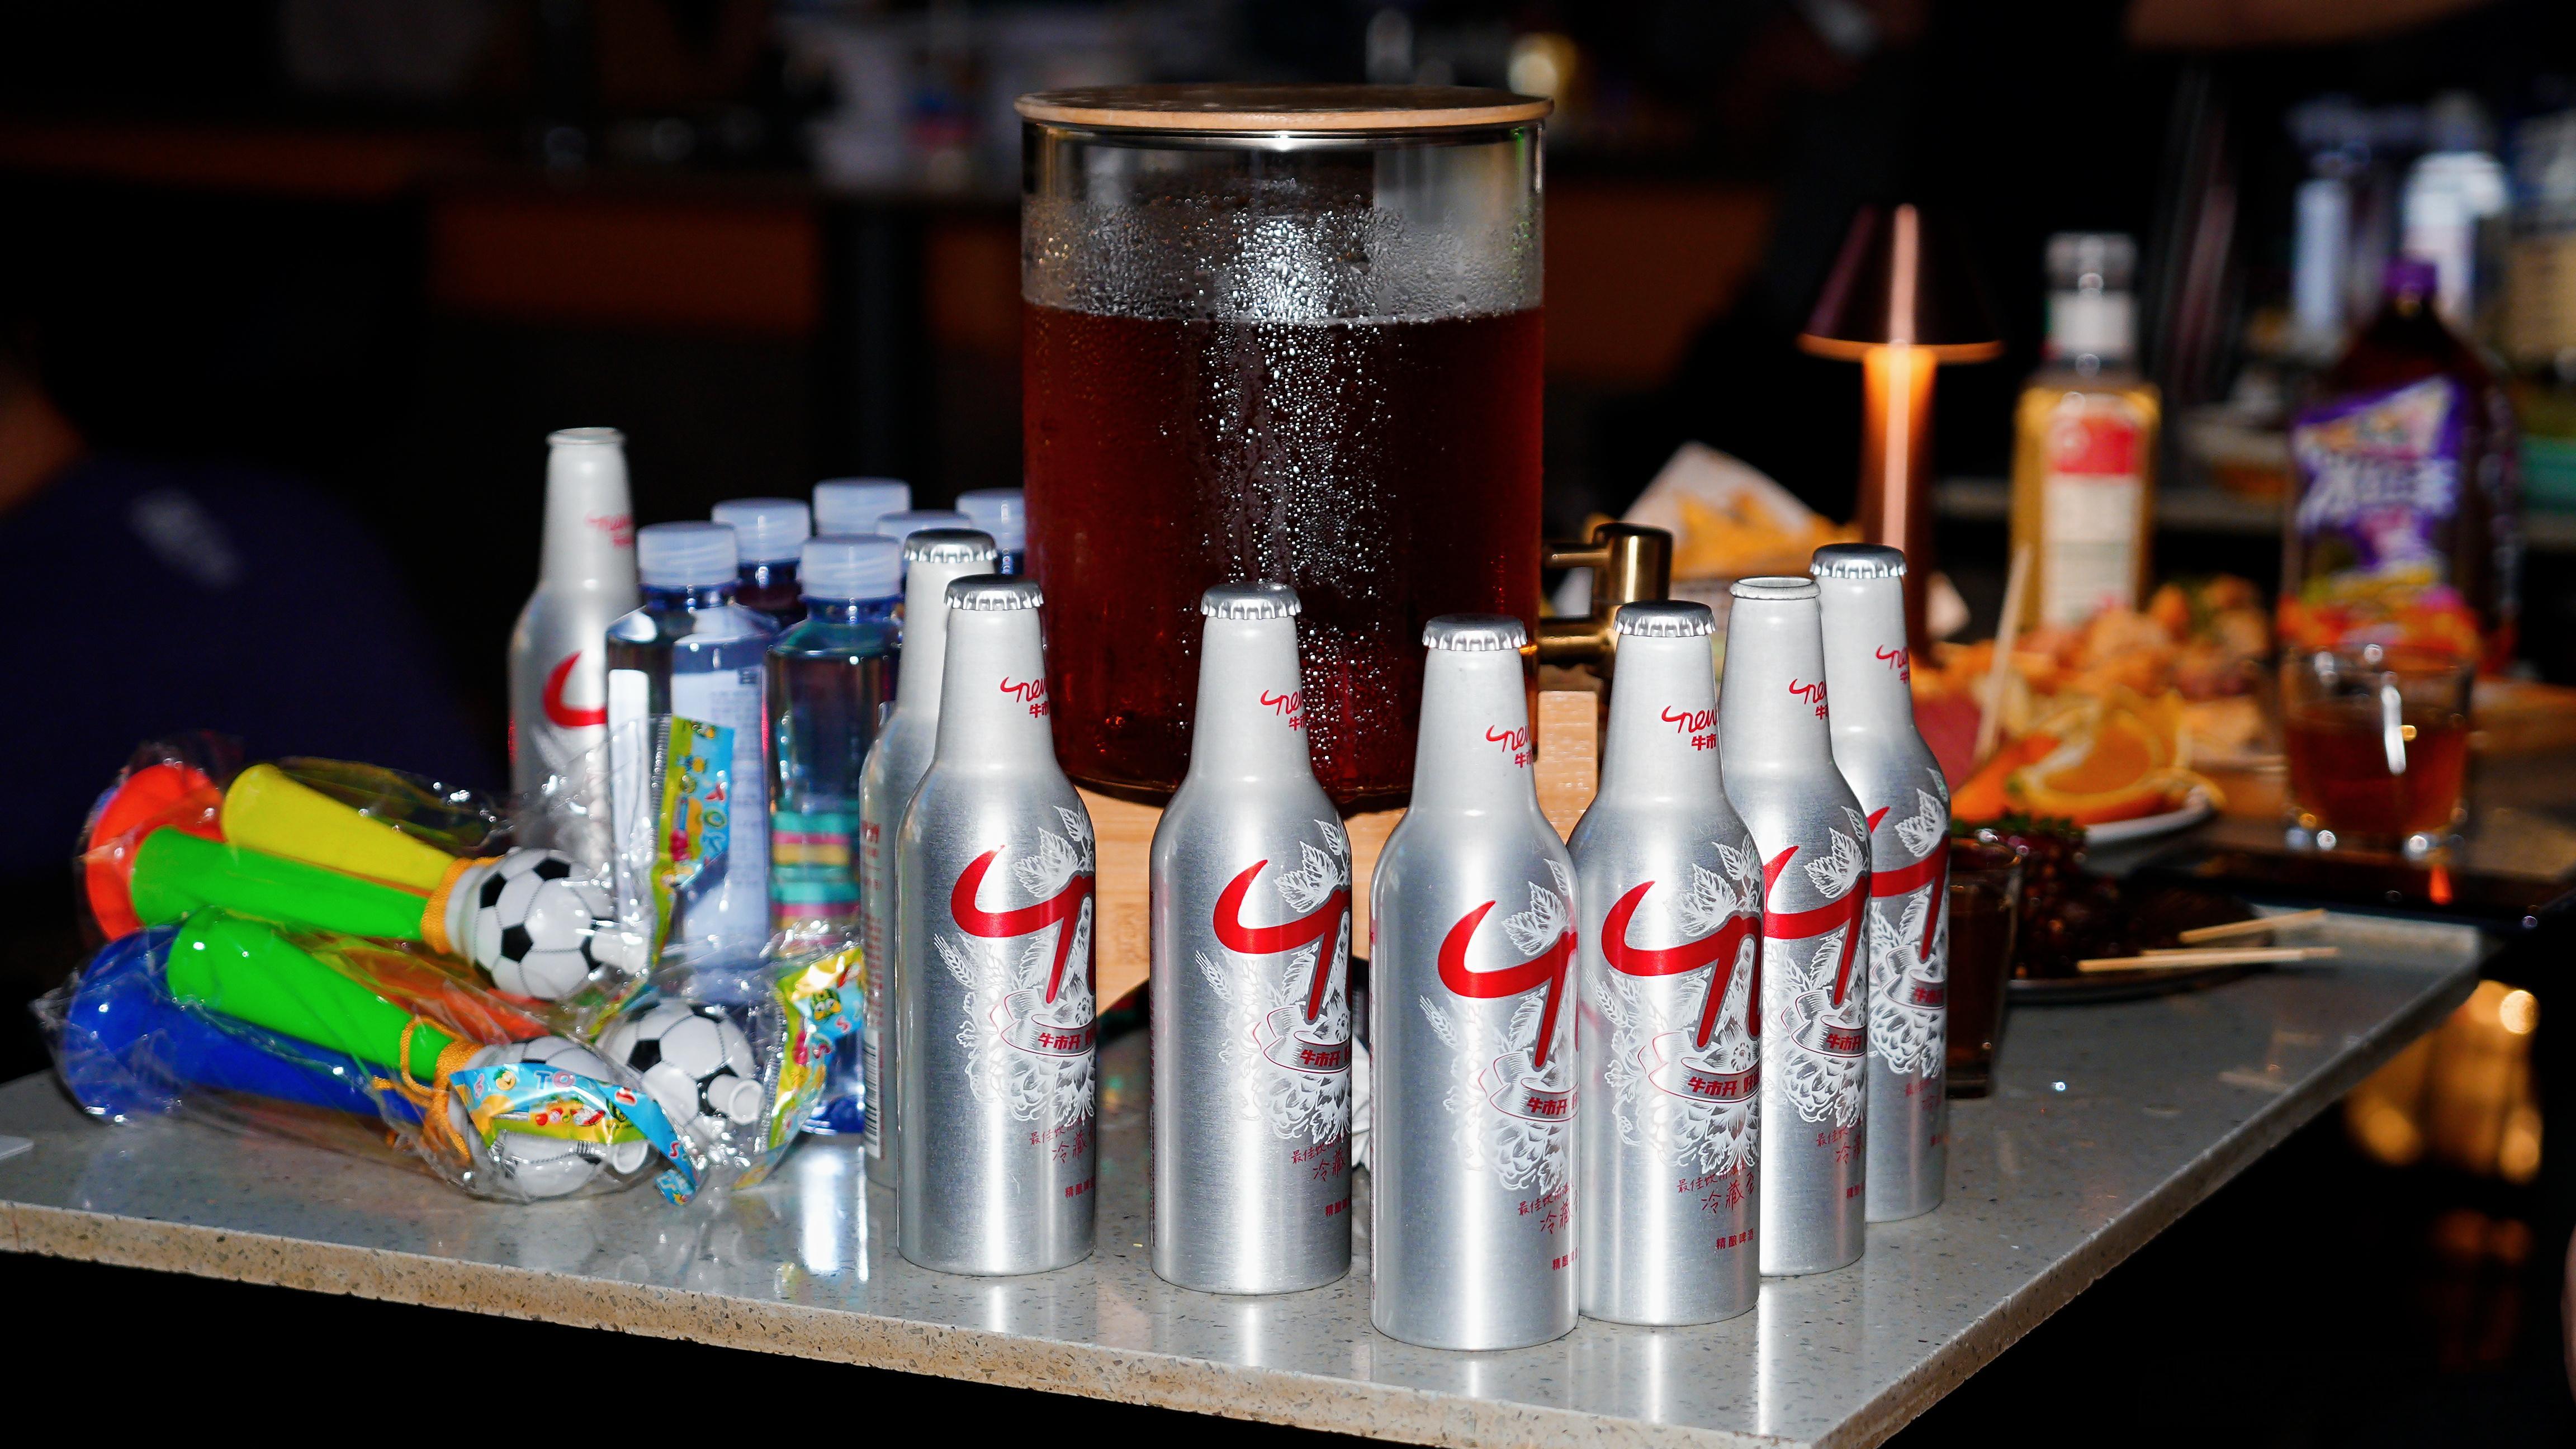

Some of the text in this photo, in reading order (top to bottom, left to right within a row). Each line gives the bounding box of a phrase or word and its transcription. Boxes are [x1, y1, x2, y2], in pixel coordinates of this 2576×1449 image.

[1789, 679, 1826, 704] ne
[1661, 703, 1718, 733] new
[1691, 733, 1717, 751] 牛市
[1038, 1033, 1081, 1050] 牛市开
[1826, 1033, 1862, 1051] 牛市开
[1300, 1049, 1340, 1067] 牛市开
[1688, 1076, 1737, 1096] 牛市开
[1527, 1097, 1568, 1115] 牛市开
